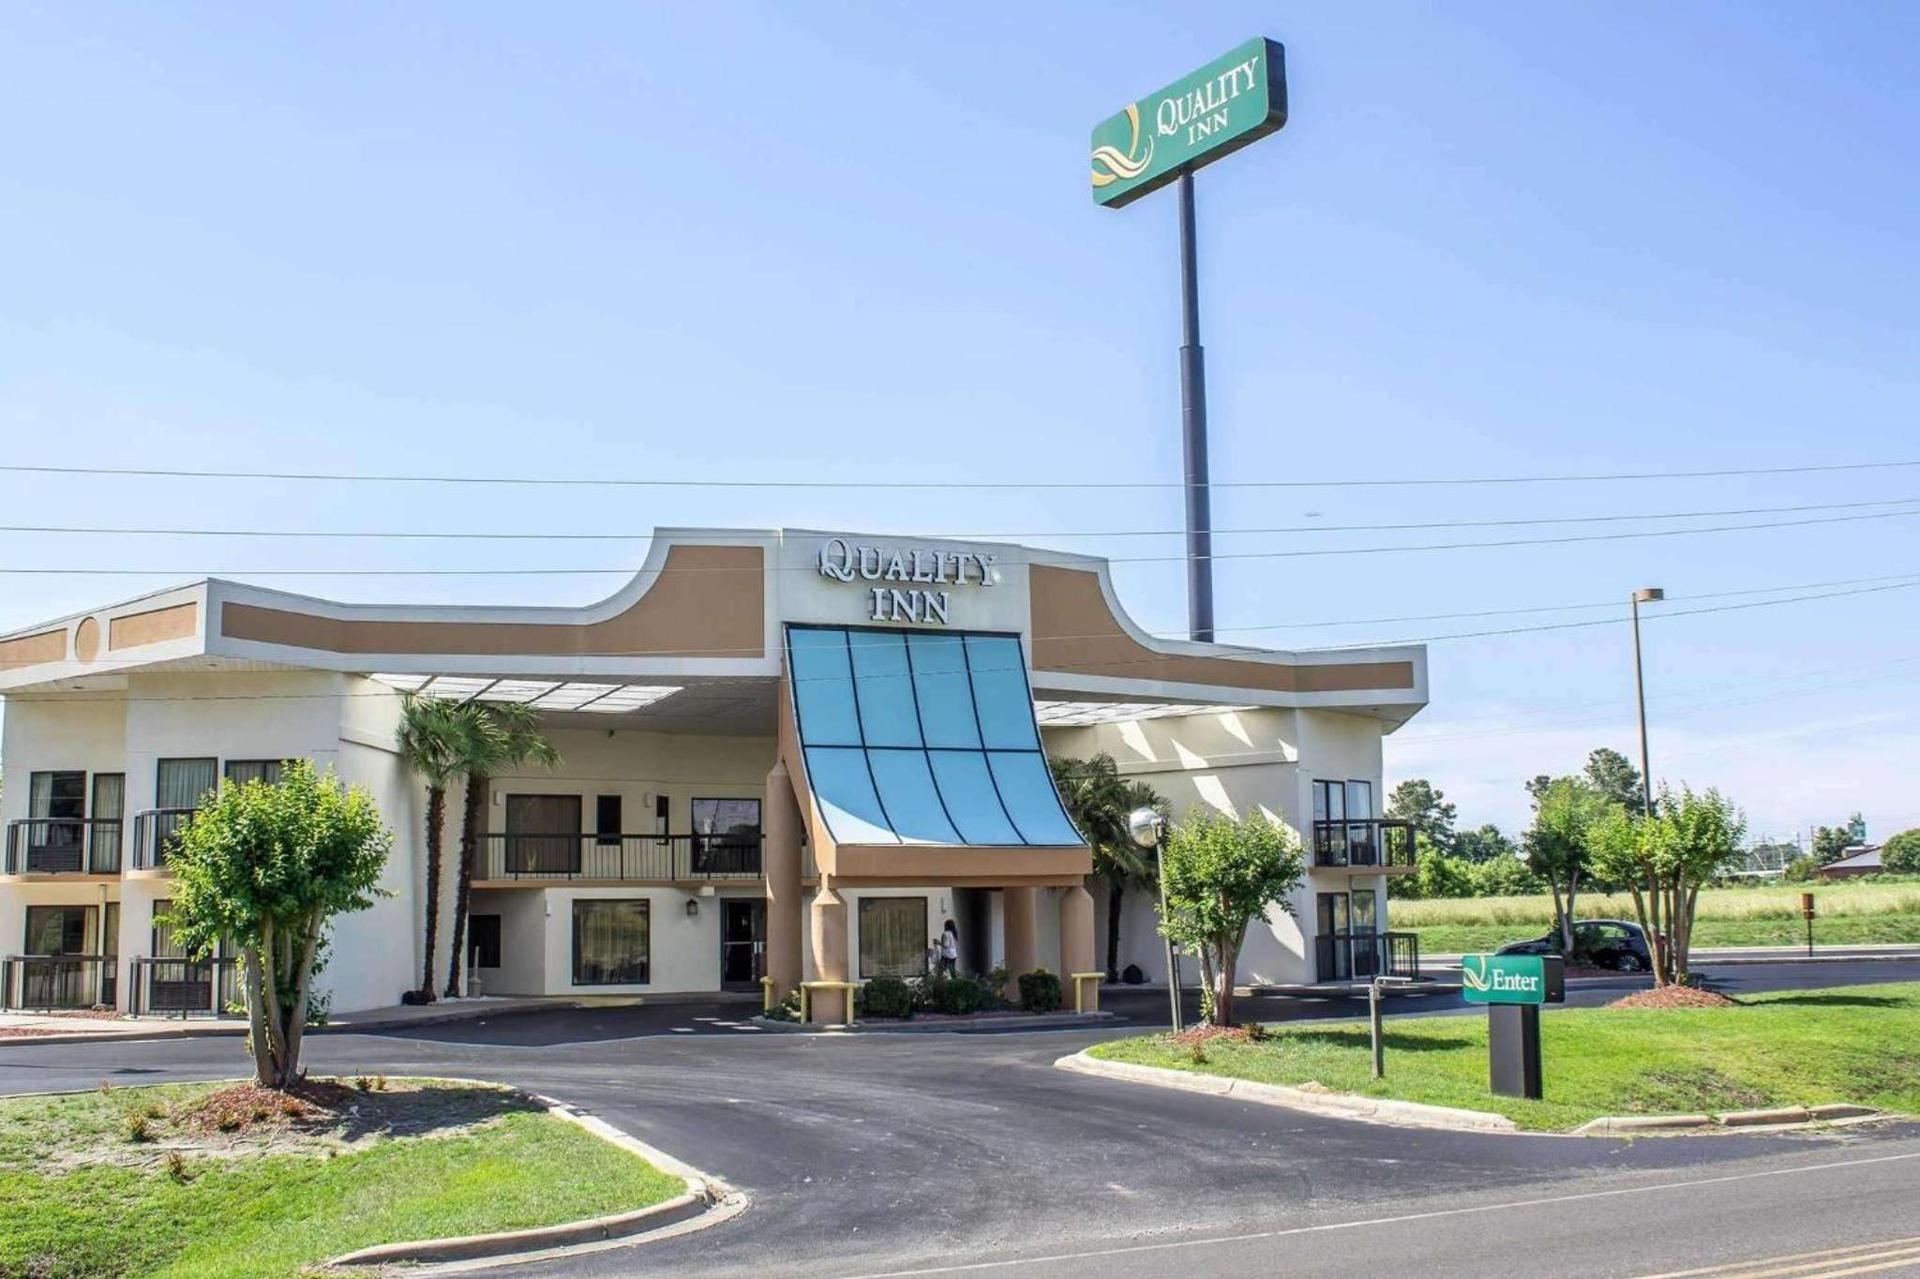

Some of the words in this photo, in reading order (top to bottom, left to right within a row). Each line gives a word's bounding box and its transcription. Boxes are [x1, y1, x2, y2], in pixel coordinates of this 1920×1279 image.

[1157, 57, 1259, 137] QUALITY
[1187, 108, 1229, 146] INN
[818, 538, 998, 587] QUALITY
[871, 587, 950, 624] INN
[1492, 969, 1538, 991] Enter
